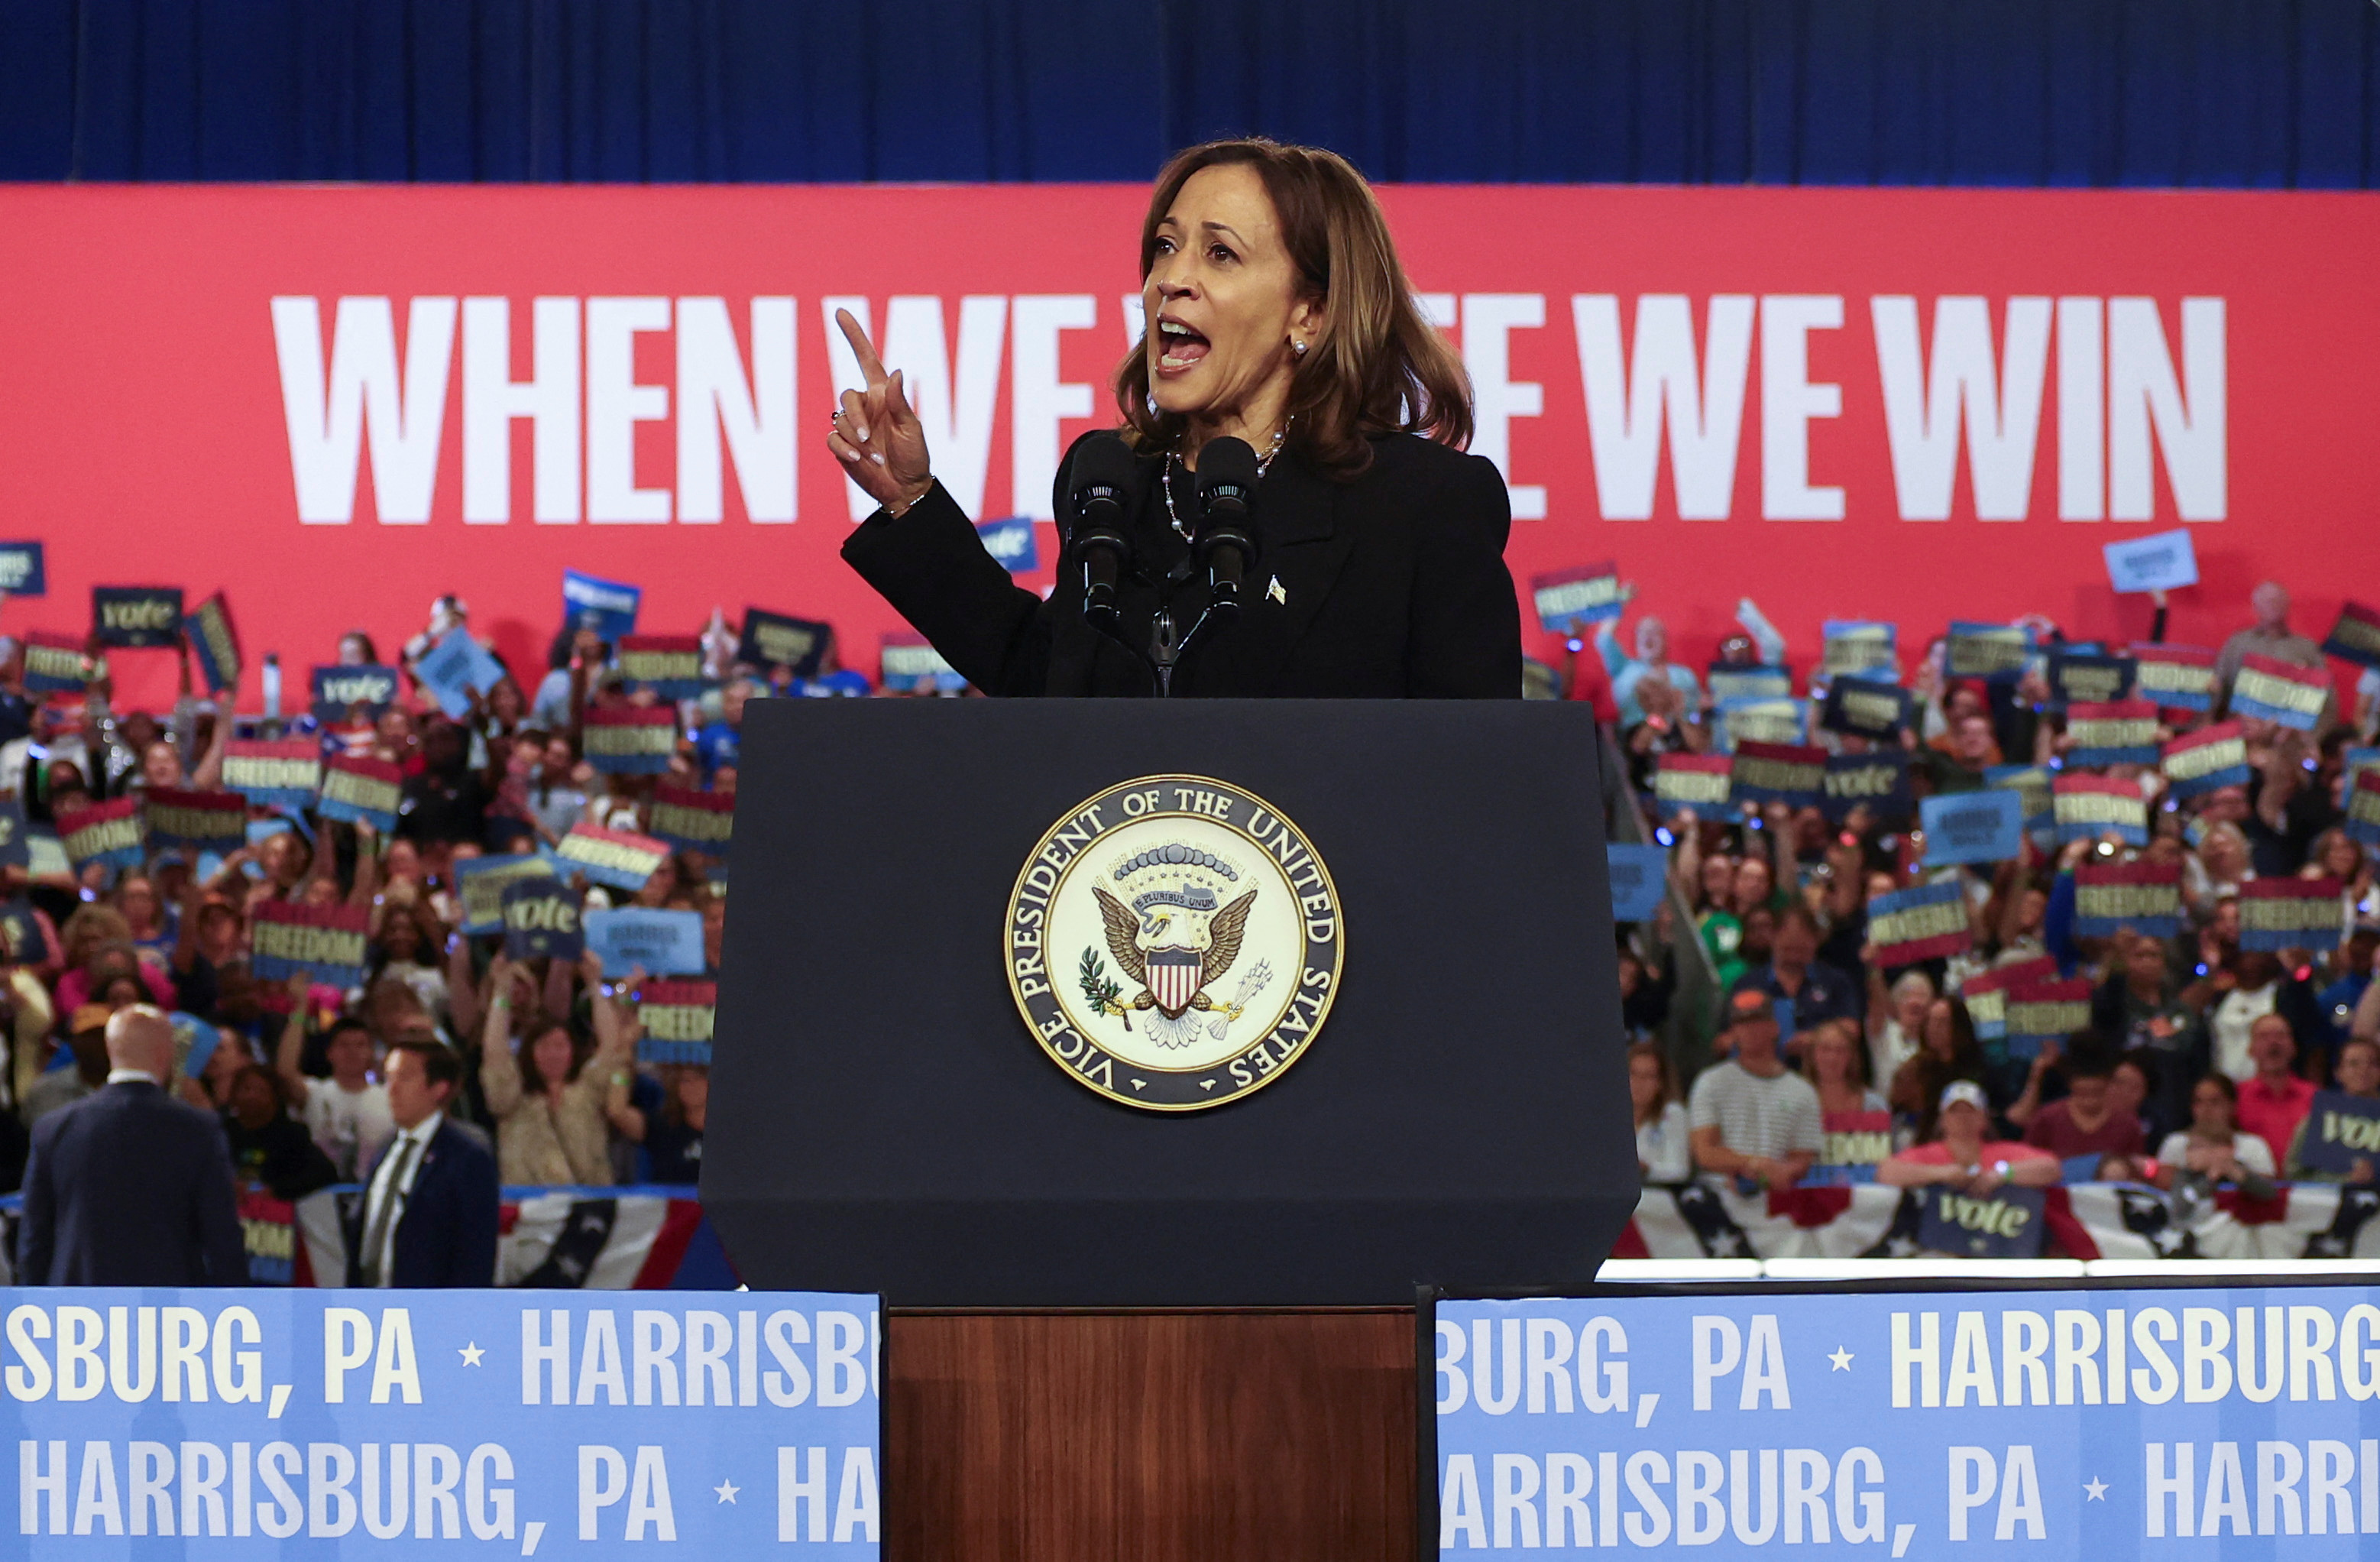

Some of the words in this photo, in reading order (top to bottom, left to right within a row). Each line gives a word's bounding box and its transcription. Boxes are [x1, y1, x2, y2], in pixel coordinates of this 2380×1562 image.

[269, 295, 798, 524] WHEN
[821, 294, 1096, 523] WE
[1571, 294, 1845, 521] WE
[1870, 295, 2227, 522] WIN
[102, 599, 176, 630] vote
[322, 676, 392, 705] vote
[1122, 789, 1161, 817] OF
[1174, 788, 1233, 819] THE
[1825, 766, 1899, 798] vote
[1012, 804, 1106, 1000] PRESIDENT
[1135, 899, 1144, 909] E
[1143, 892, 1185, 905] PLURIBUS
[1189, 896, 1216, 908] UNUM
[1246, 807, 1335, 944] UNITED
[254, 919, 368, 967] FREEDOM
[1038, 1010, 1115, 1090] VICE
[1227, 966, 1331, 1089] STATES
[1939, 1193, 2031, 1238] vote
[5, 1304, 293, 1419] SBURG,
[324, 1308, 423, 1405] PA
[521, 1308, 879, 1408] HARRISB
[1436, 1315, 1660, 1428] BURG,
[1692, 1314, 1792, 1411] PA
[1891, 1304, 2380, 1408] HARRISBURG
[19, 1440, 546, 1557] HARRISBURG,
[578, 1445, 677, 1541] PA
[778, 1446, 880, 1543] HA
[1439, 1447, 1917, 1558] ARRISBURG,
[1948, 1445, 2047, 1541] PA
[2146, 1439, 2378, 1538] HARRI
